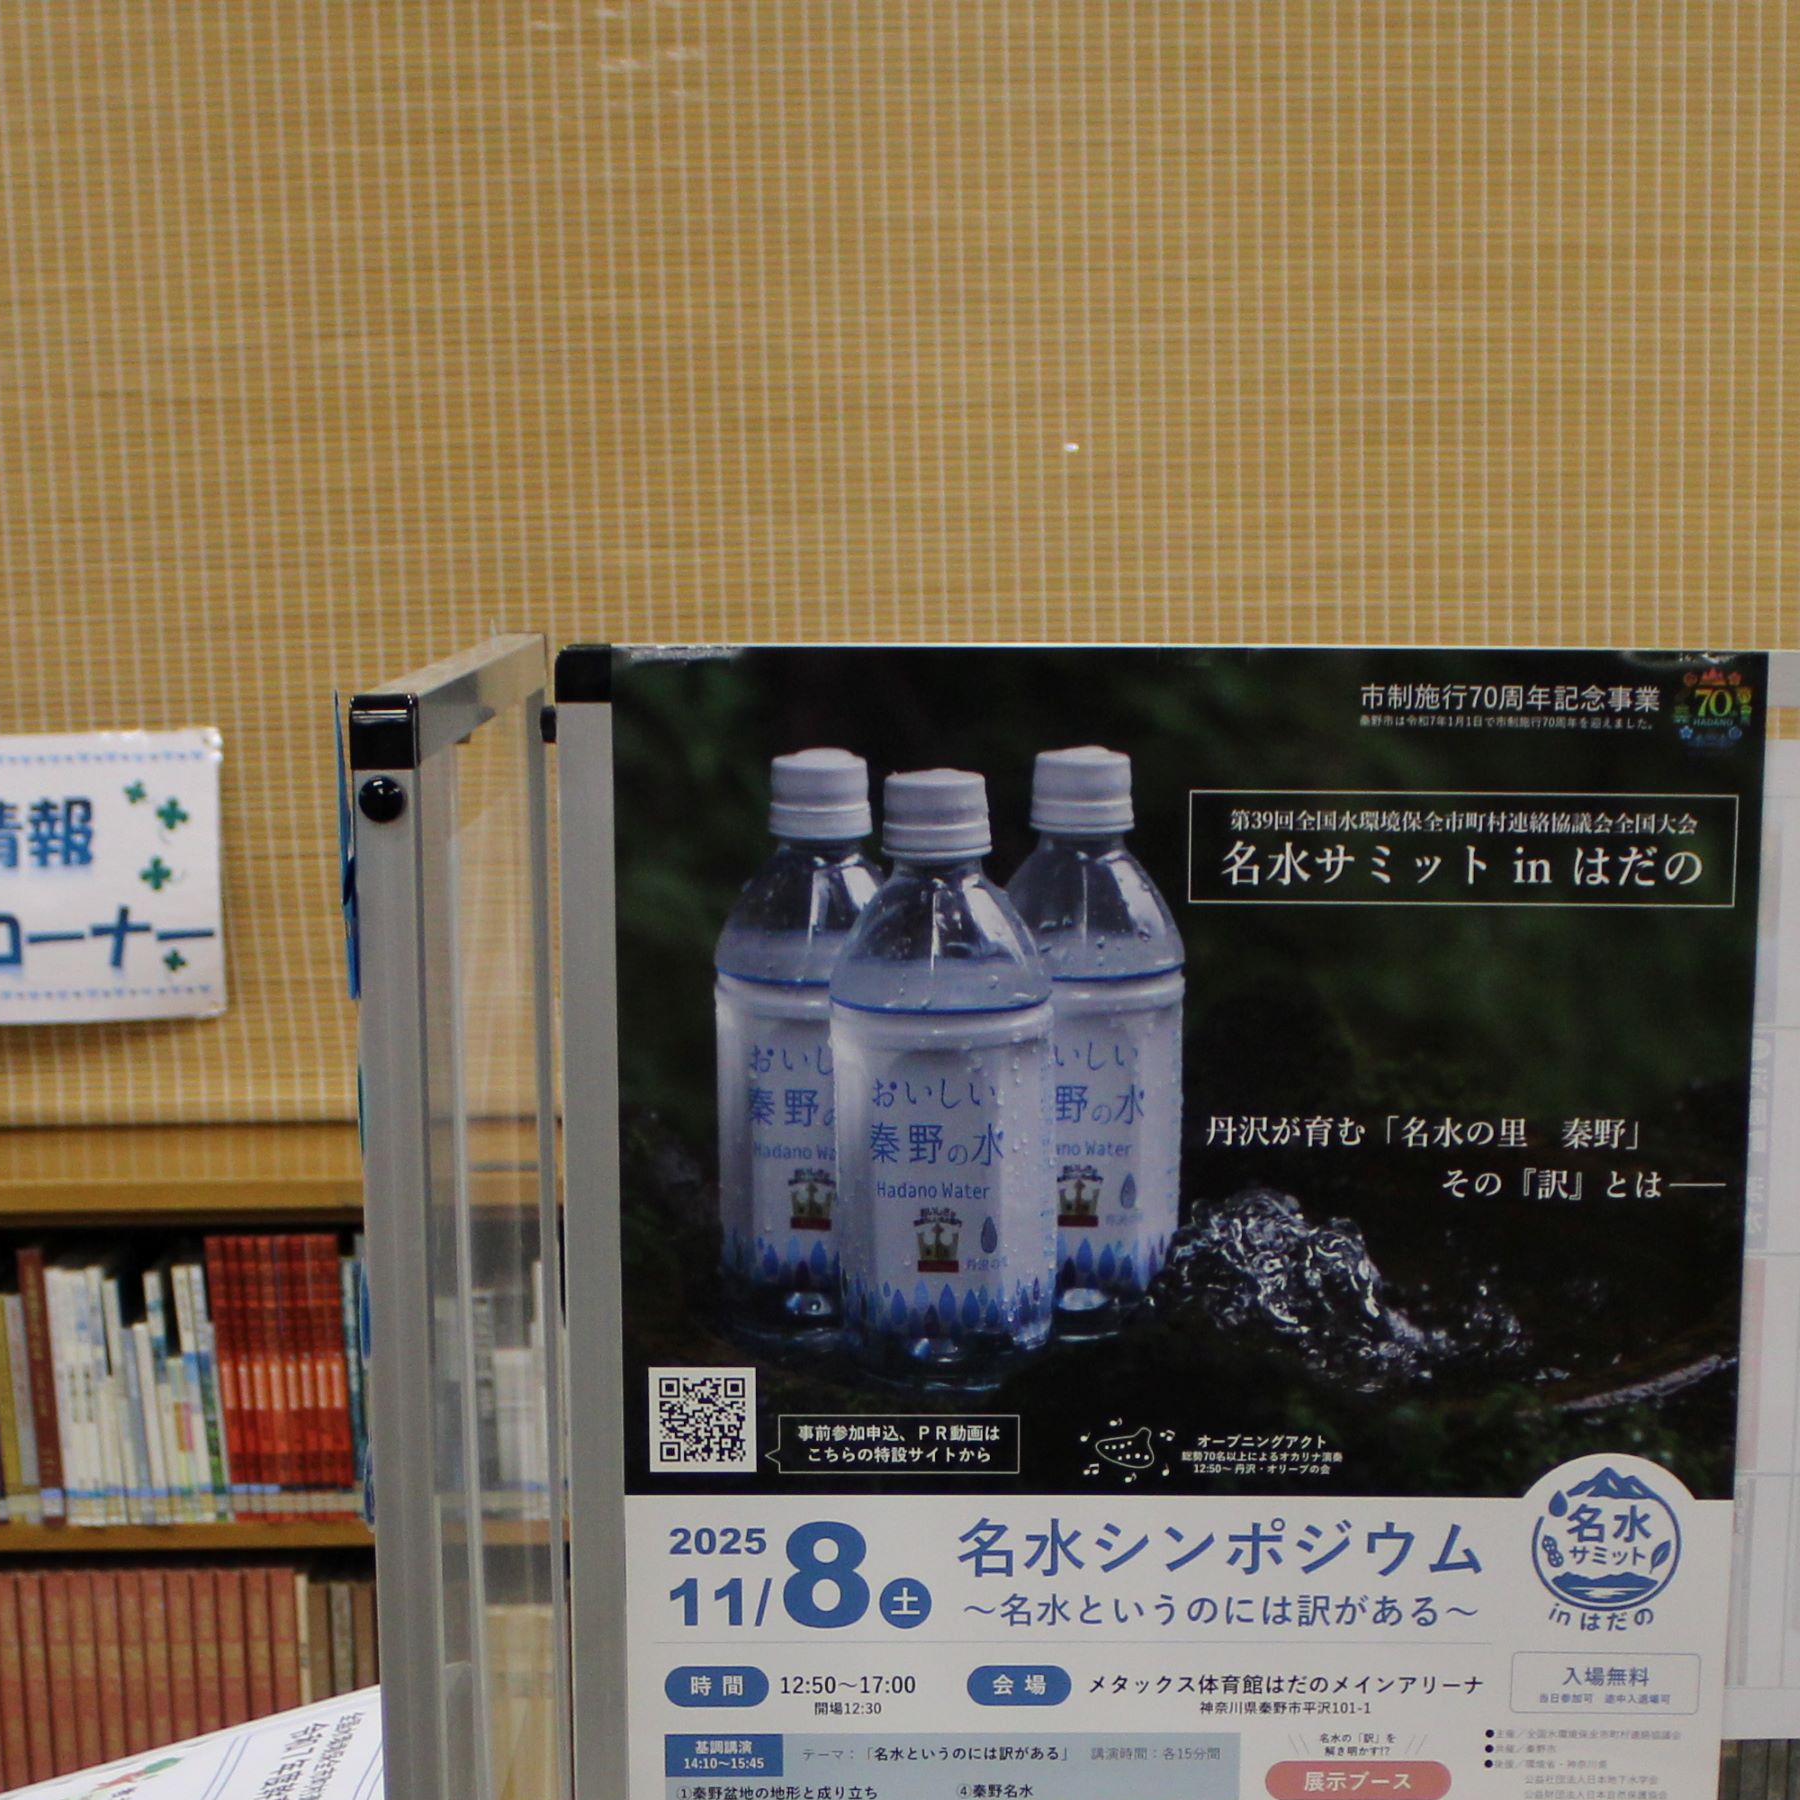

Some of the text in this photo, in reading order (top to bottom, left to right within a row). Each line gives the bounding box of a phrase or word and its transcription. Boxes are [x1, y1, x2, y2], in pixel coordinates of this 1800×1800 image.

[1360, 683, 1659, 712] 市制施行70周年記念事業
[1230, 809, 1699, 836] 第39回全国水環境保全市町村連絡協議会全国大会
[1221, 841, 1704, 888] 名水サミット in はだの
[872, 1079, 997, 1109] おいしい
[870, 1122, 1005, 1166] 秦野の水
[877, 1184, 990, 1200] Hadano Water
[808, 1446, 991, 1464] こちらの特設サイトから
[1197, 1434, 1327, 1450] オープニングアクト
[1567, 1504, 1652, 1543] 名水
[669, 1527, 767, 1556] 2025
[957, 1516, 1484, 1578] 名水シンポジウム
[1569, 1545, 1646, 1566] サミット
[890, 1589, 921, 1618] 土
[1548, 1604, 1655, 1632] in はだの
[691, 1675, 744, 1696] 時間
[993, 1674, 1046, 1696] 会場
[1088, 1673, 1484, 1697] メタックス体育館はだのメインアリーナ
[1562, 1667, 1650, 1688] 入場無料
[815, 1701, 1372, 1716] 開場12:30 神奈川県秦野市平沢101-1
[677, 1786, 878, 1800] ①秦野盆地の地形と成り立ち
[1304, 1771, 1412, 1792] 展示ブース
